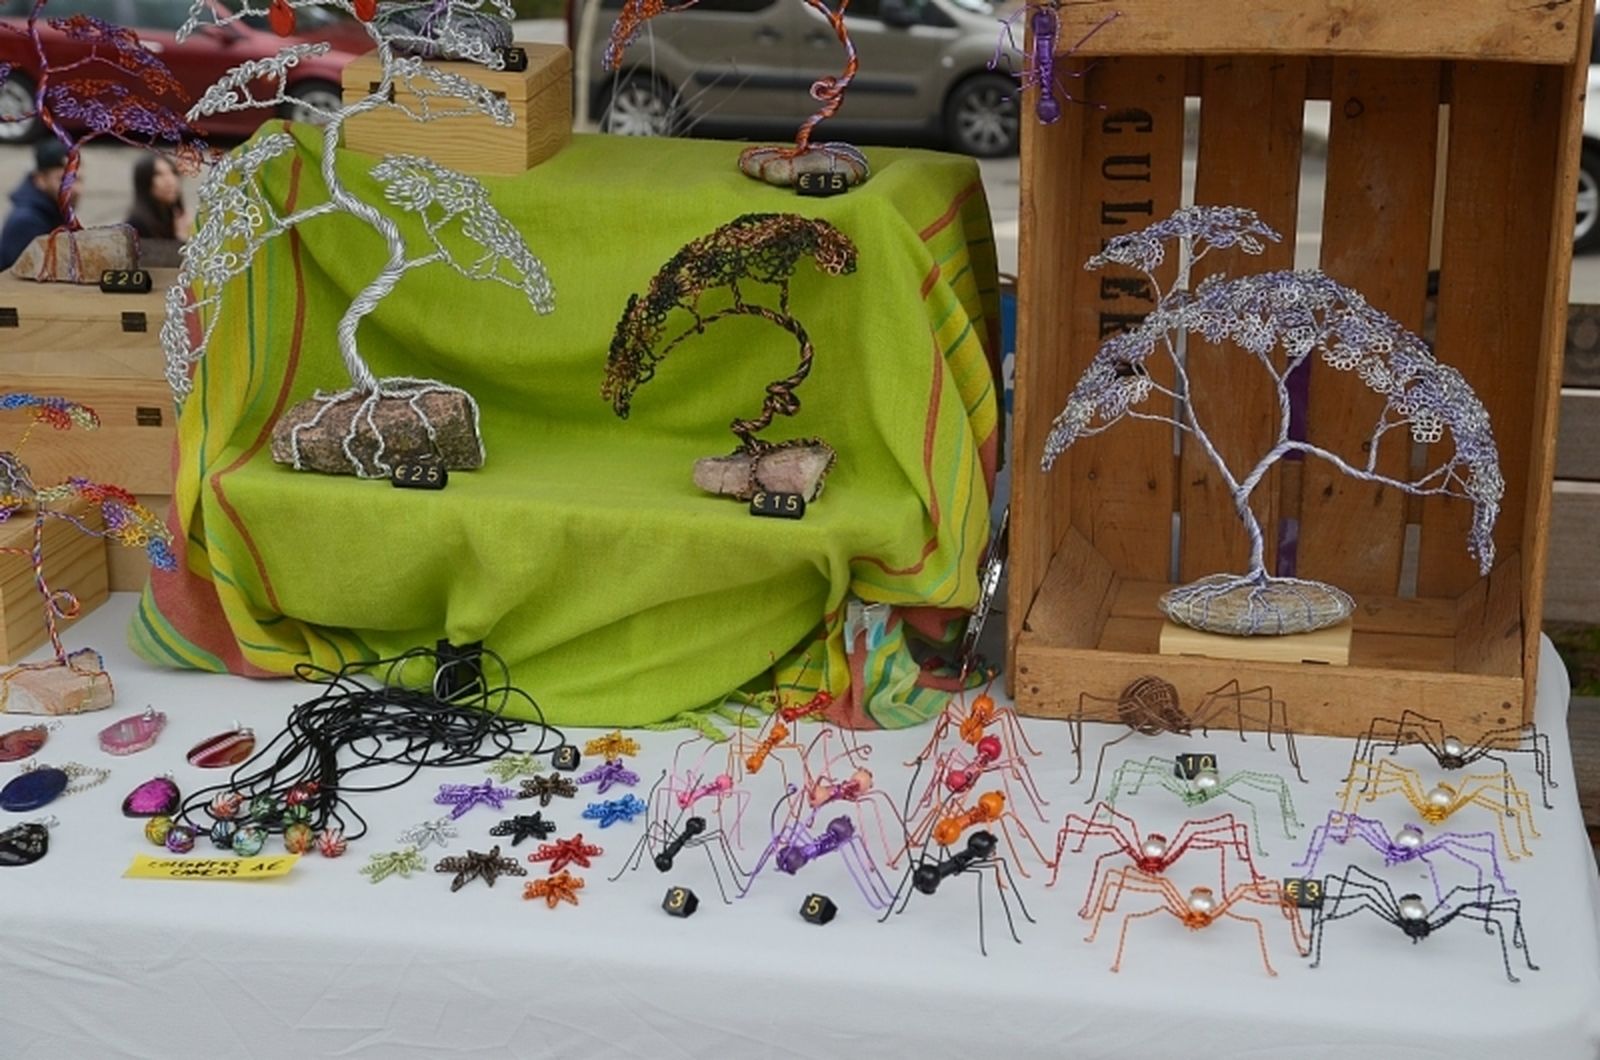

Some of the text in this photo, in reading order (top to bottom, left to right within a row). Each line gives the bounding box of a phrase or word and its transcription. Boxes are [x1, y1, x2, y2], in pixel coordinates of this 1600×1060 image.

[799, 173, 843, 189] €15
[103, 271, 143, 285] €20
[394, 465, 439, 482] €25
[752, 492, 798, 511] €15
[559, 747, 572, 763] 3
[1186, 755, 1213, 771] 10
[669, 889, 685, 908] 3
[1286, 880, 1320, 901] €3
[806, 896, 821, 915] 5
